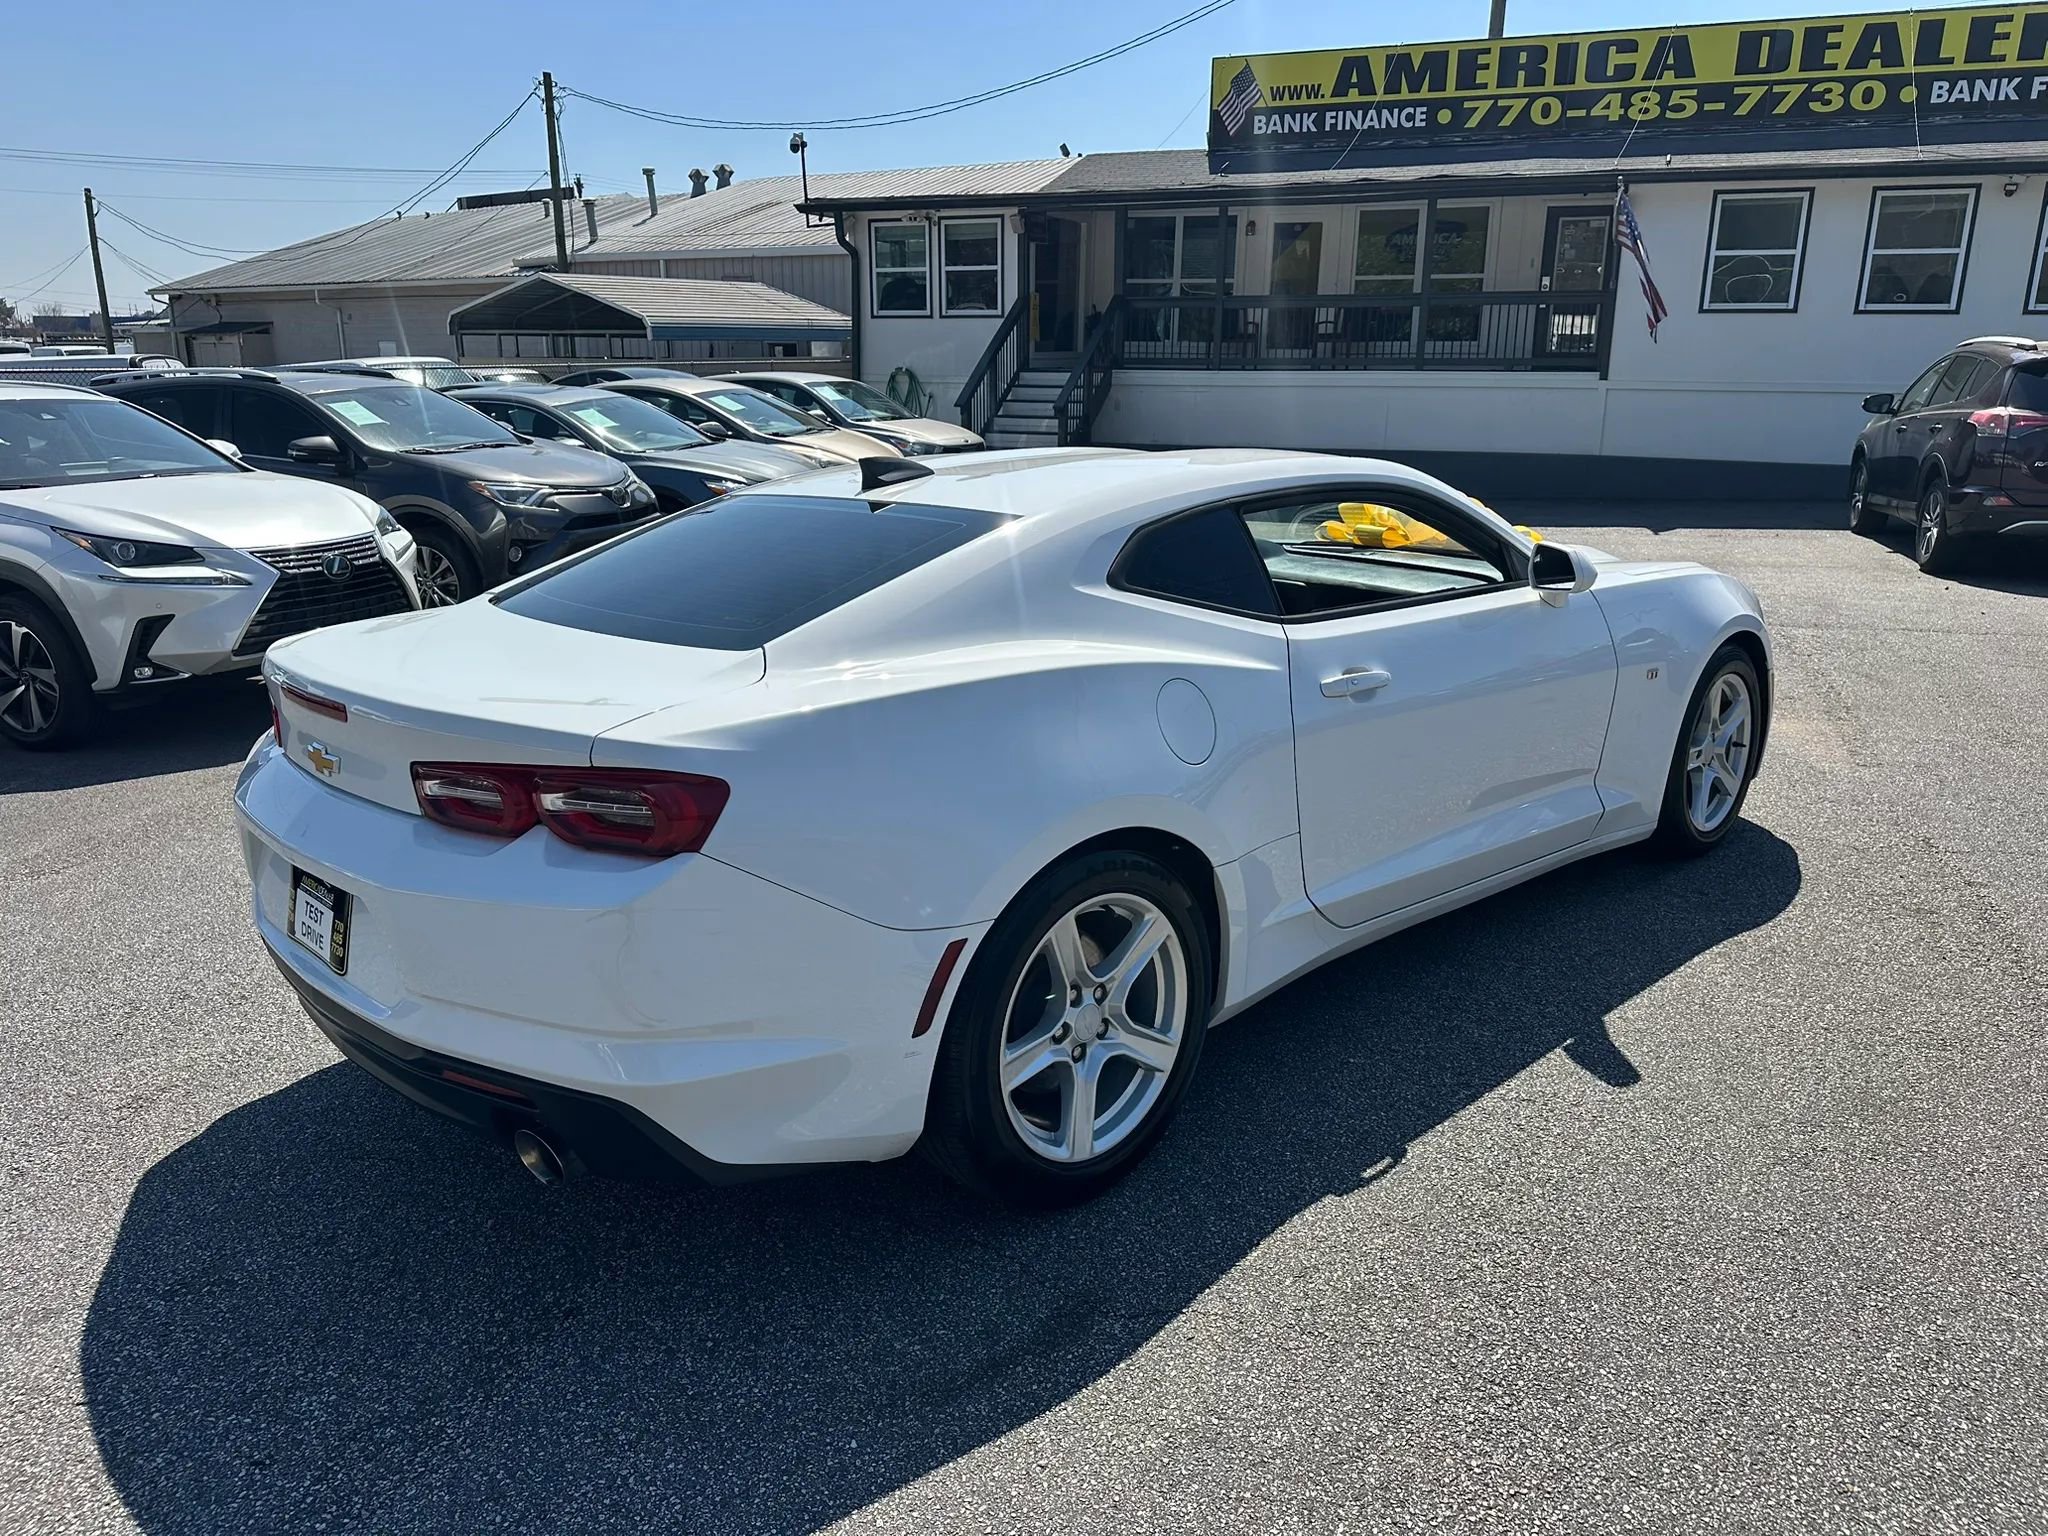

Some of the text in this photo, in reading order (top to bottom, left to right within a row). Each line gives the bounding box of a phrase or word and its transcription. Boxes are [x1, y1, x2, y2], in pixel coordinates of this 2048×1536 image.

[1330, 35, 1697, 98] AMERICA
[1253, 111, 1318, 135] BANK
[1325, 106, 1428, 131] FINANCE
[1463, 79, 1887, 129] 770-485-7730
[1929, 77, 2022, 104] BANK
[1390, 232, 1464, 245] AMICA
[304, 900, 325, 926] TEST
[301, 920, 324, 951] DRIVE
